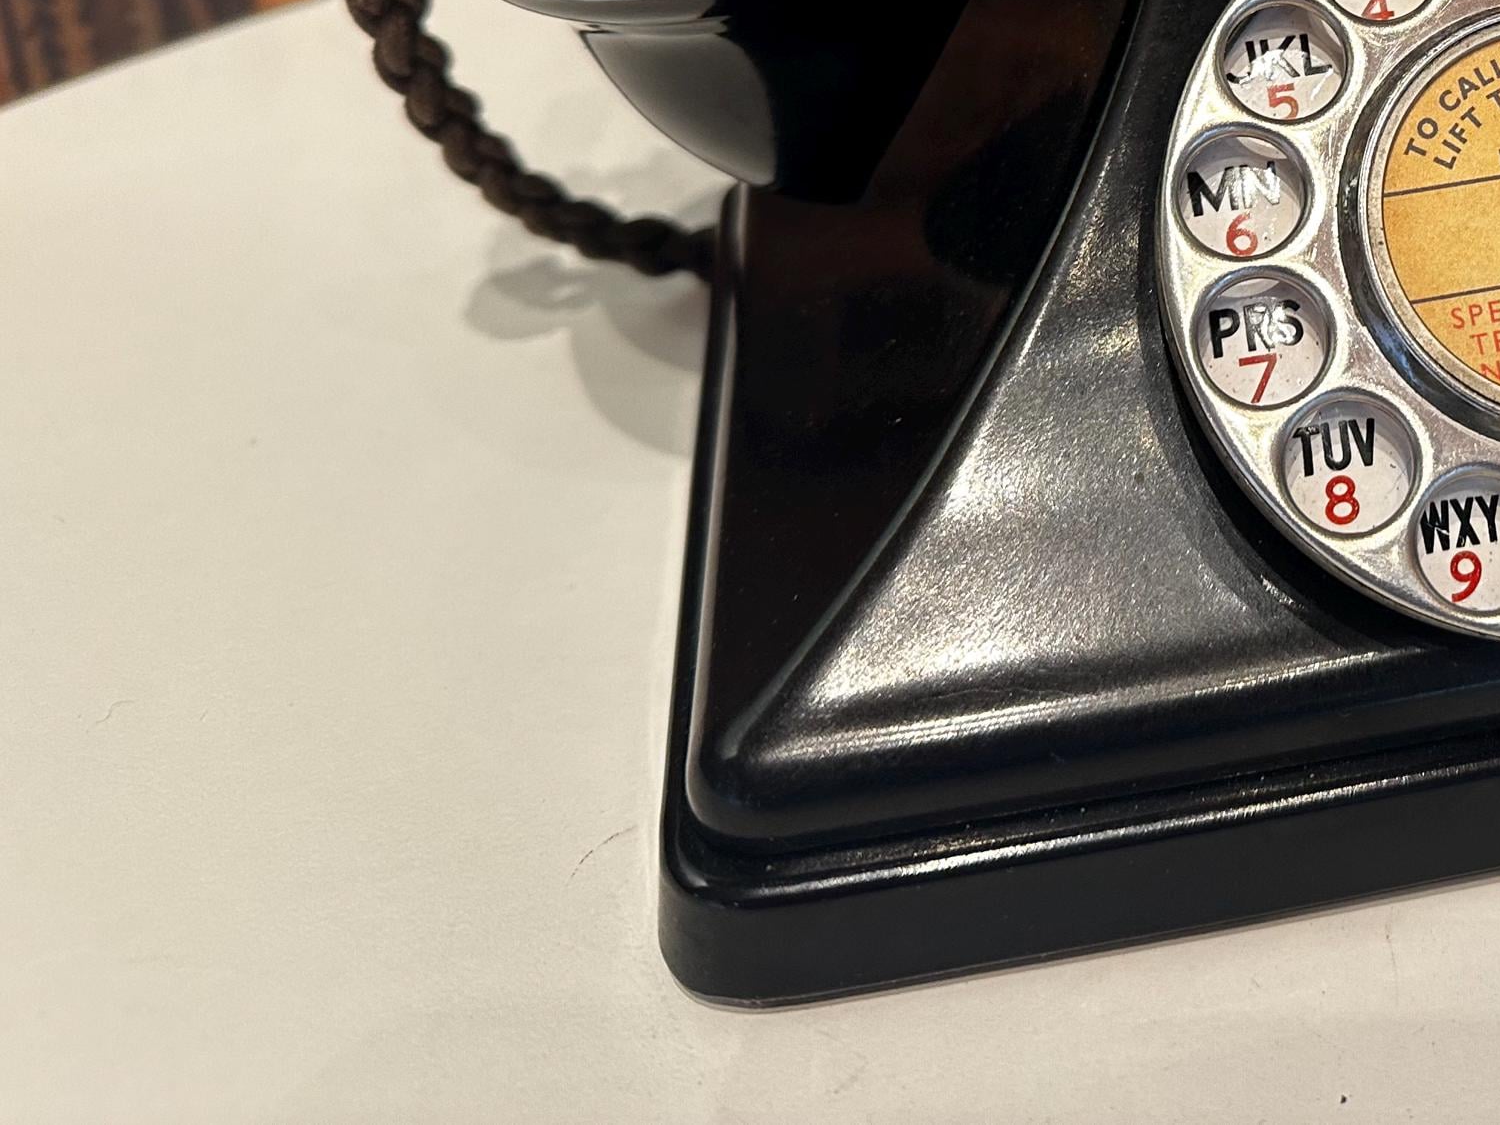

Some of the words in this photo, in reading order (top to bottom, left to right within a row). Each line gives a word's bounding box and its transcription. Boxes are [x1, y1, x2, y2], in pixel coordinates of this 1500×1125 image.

[1226, 34, 1332, 85] JKL
[1267, 83, 1298, 119] 5
[1403, 117, 1439, 159] TO
[1432, 106, 1483, 170] LIFT
[1226, 213, 1258, 257] 6
[1208, 299, 1304, 359] PRS
[1238, 353, 1277, 404] 7
[1292, 417, 1375, 477] TUV
[1325, 475, 1360, 525] 8
[1420, 494, 1500, 554] WXY
[1449, 551, 1482, 602] 9
